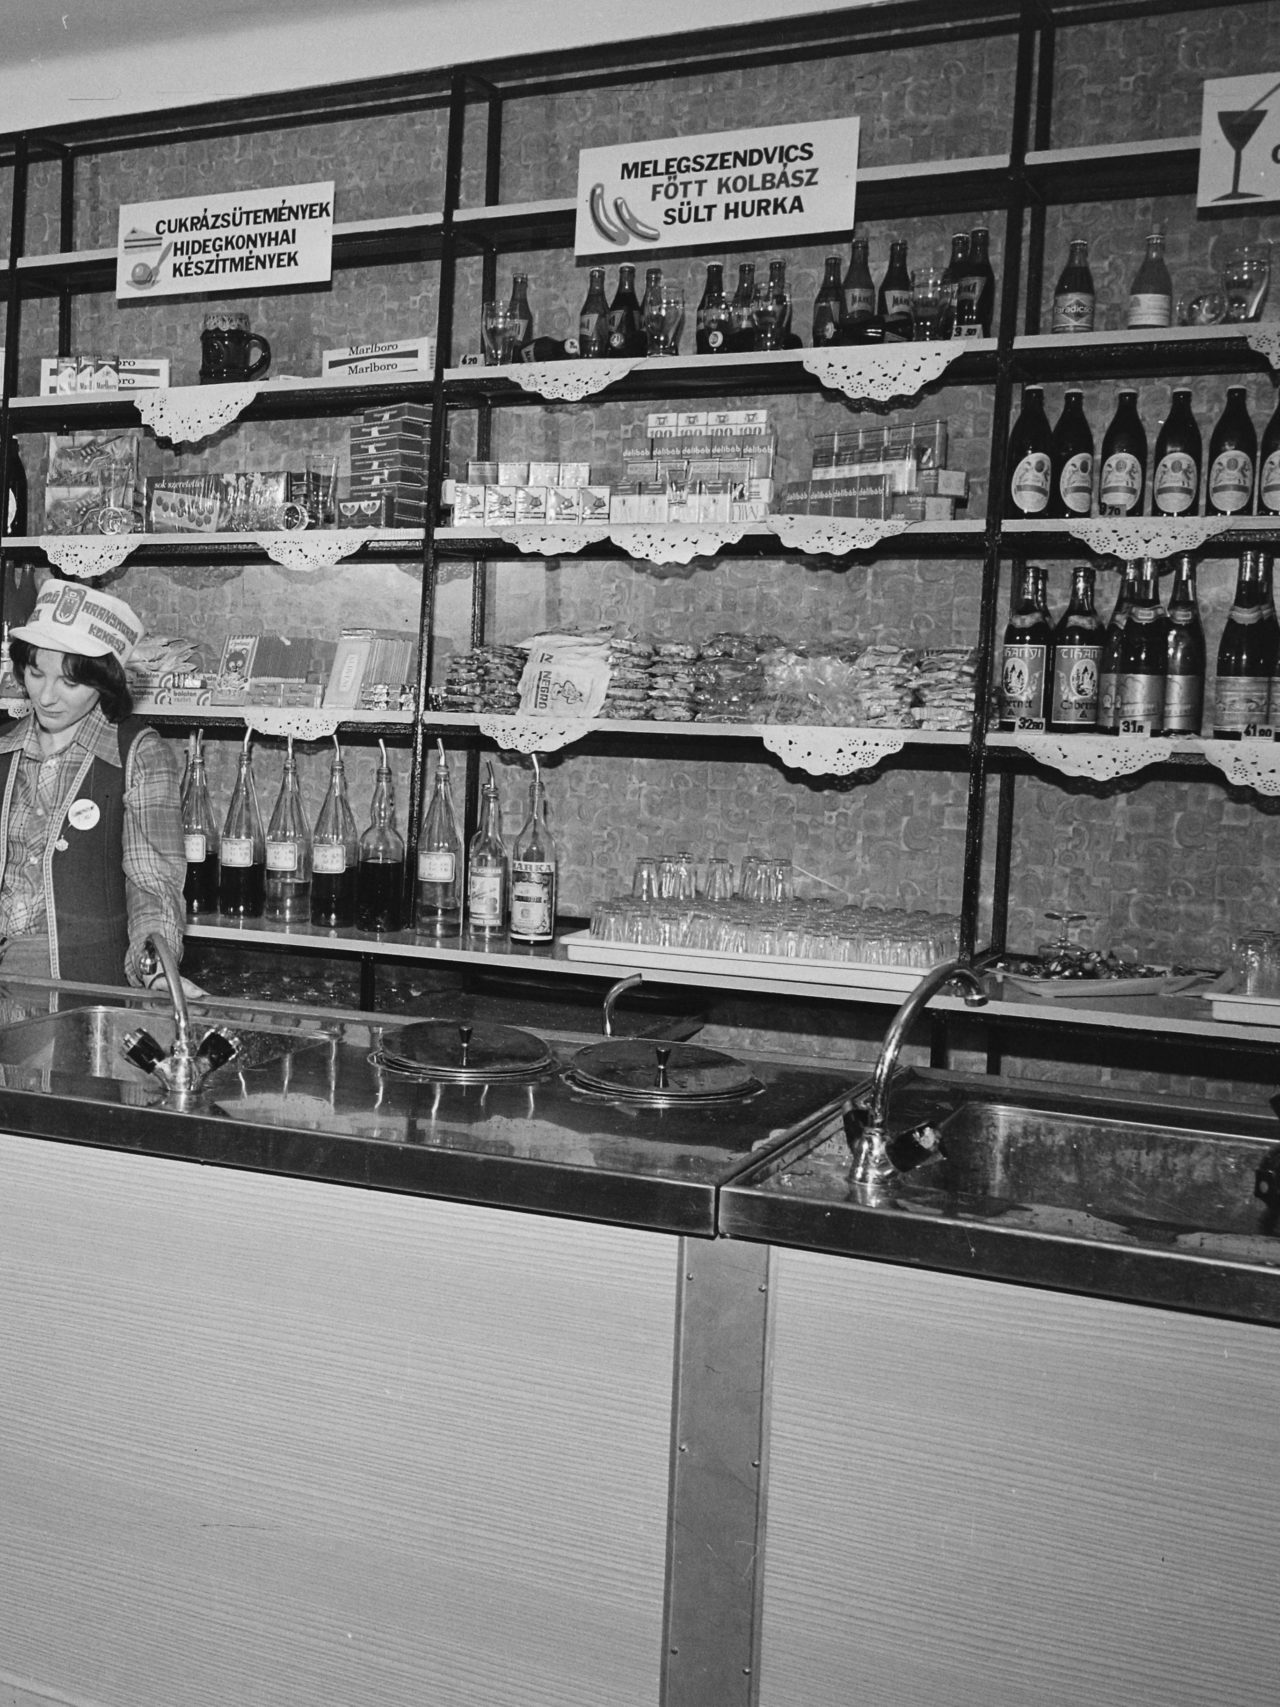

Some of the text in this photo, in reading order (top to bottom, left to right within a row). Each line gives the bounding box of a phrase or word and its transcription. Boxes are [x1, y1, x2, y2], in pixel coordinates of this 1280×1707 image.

[621, 142, 815, 180] MELEGSZENDVICS
[717, 163, 819, 195] KOLBÁSZ
[155, 199, 331, 235] CUKRÁZSÜTEMÉNYEK
[663, 195, 805, 225] SÜLT HURKA
[173, 228, 297, 257] HIDEGKONYHAI
[172, 250, 299, 278] KÉSZÍTMÉNYEK
[348, 343, 399, 356] Marlboro
[348, 362, 398, 375] Marlboro
[538, 670, 553, 710] NEGRO
